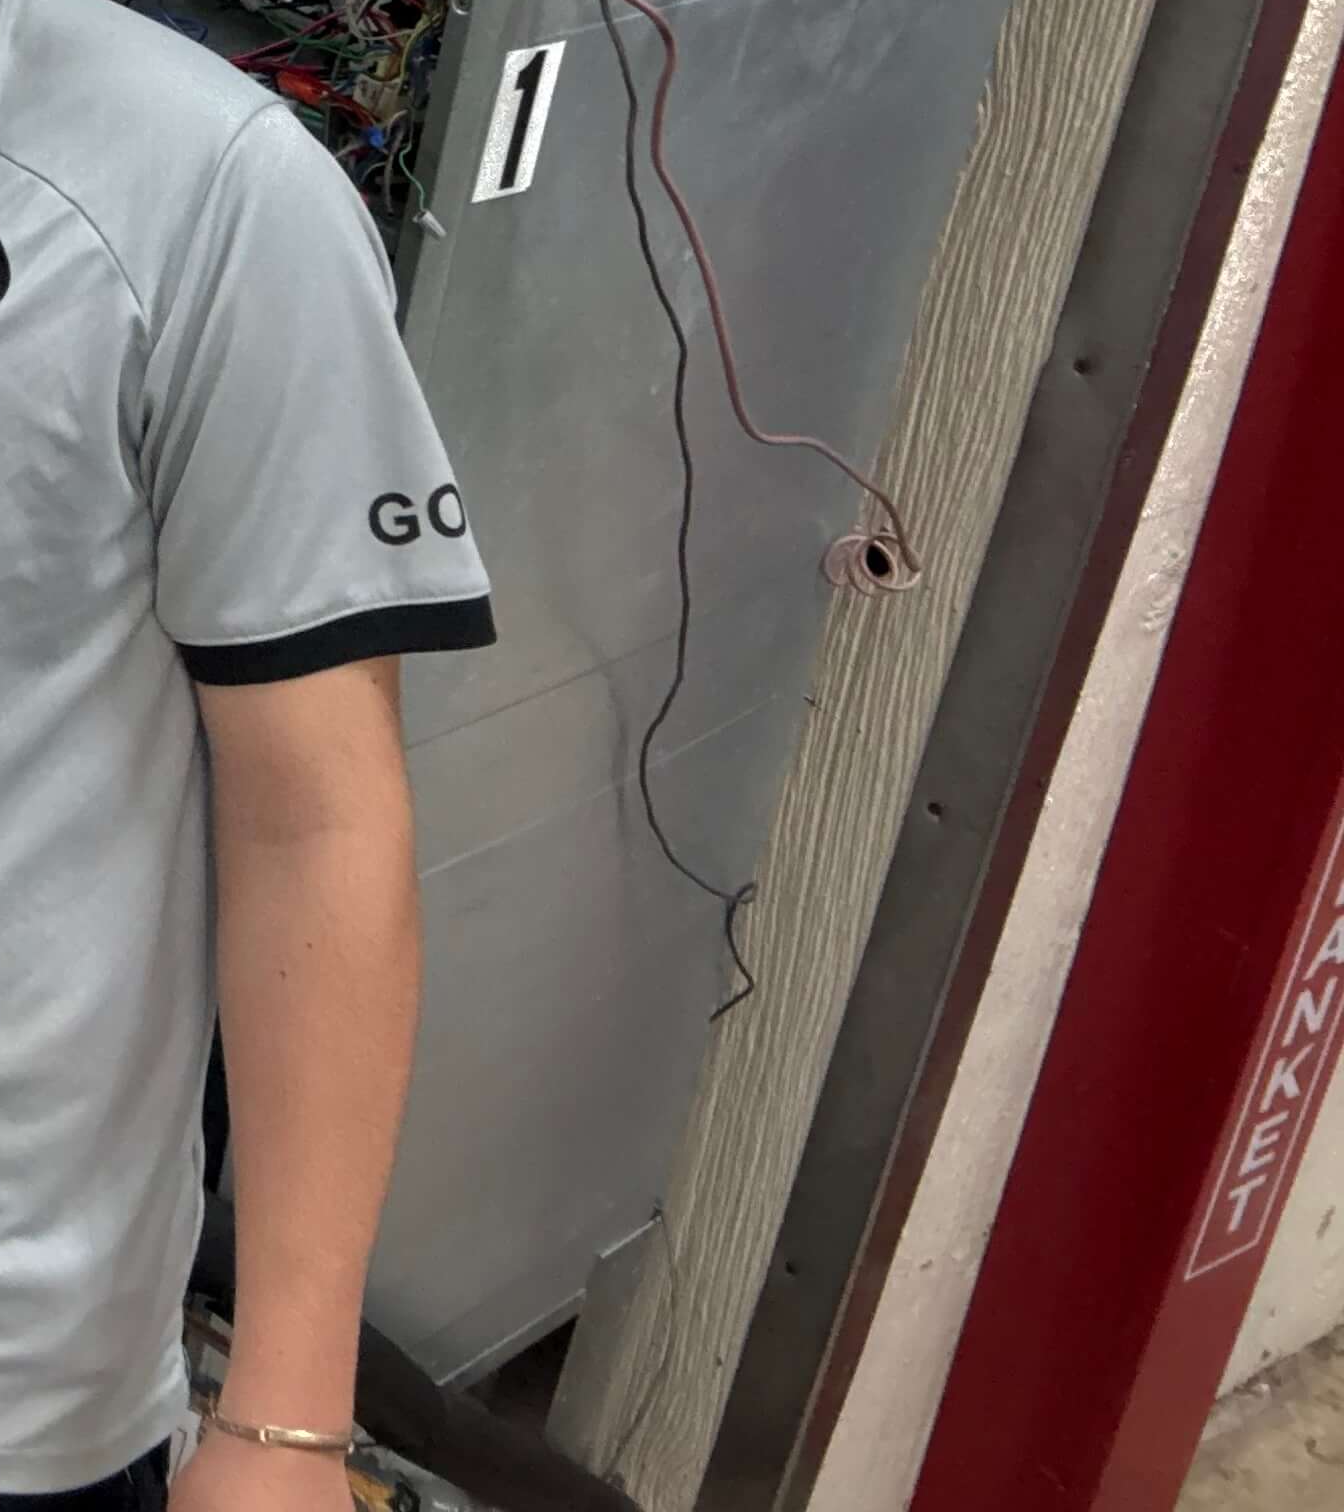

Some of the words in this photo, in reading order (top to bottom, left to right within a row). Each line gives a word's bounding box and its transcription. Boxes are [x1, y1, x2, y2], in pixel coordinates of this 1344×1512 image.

[498, 49, 549, 191] 1
[368, 483, 466, 546] GO
[1227, 876, 1344, 1232] ANKET
